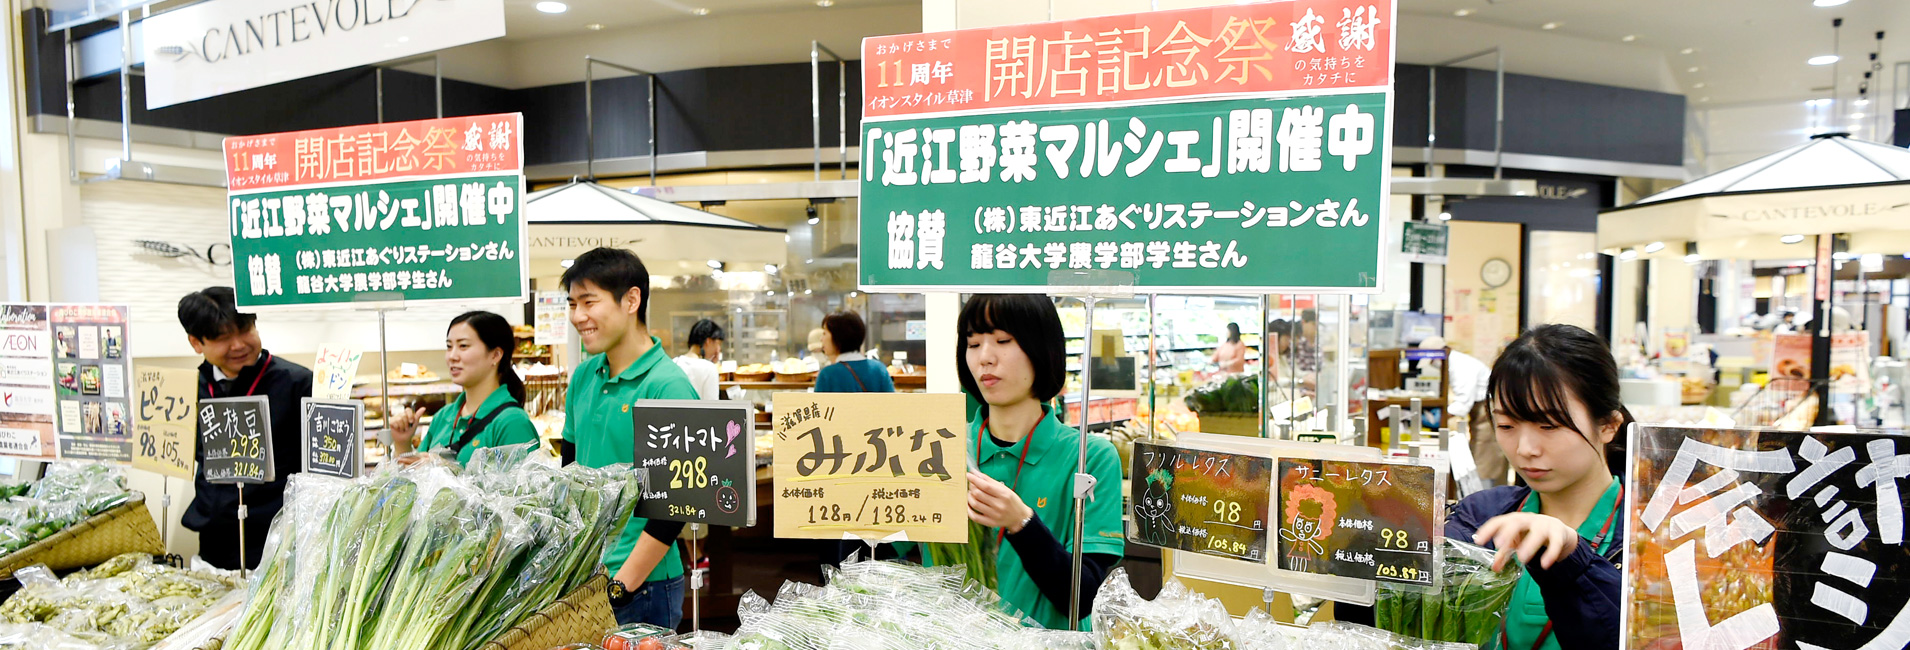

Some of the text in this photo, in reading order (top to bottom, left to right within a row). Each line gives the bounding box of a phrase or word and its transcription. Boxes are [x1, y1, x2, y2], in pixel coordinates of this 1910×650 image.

[1284, 4, 1381, 54] 感謝
[876, 38, 951, 56] おかげさまで
[984, 15, 1278, 102] 開店記念祭
[877, 59, 954, 88] 11周年
[1295, 55, 1365, 71] の気持ちを
[1303, 72, 1356, 86] カタチに
[868, 88, 973, 110] イオンスタイル草津
[231, 138, 276, 149] おかげさまで
[294, 126, 459, 181] 開店記念祭
[466, 153, 505, 162] の気持ちを
[866, 103, 1375, 187] 「近江野菜マルシェ」開催中
[233, 152, 278, 171] 11周年
[231, 172, 289, 187] イオンスタイル草津
[232, 181, 514, 239] 「近江野菜マルシェ」開催中
[1742, 203, 1878, 222] CANTEVOLE
[529, 237, 619, 248] ANTEVOLE
[887, 209, 946, 271] 協賛
[970, 240, 1248, 270] 龍谷大学農学部学生さん
[248, 252, 283, 296] 協賛
[296, 269, 452, 294] 龍谷大学農学部学生さん
[140, 386, 190, 421] ピーマン
[780, 402, 821, 430] 滋賀県産
[200, 404, 261, 443] 黒枝豆
[647, 423, 722, 453] ミディトマト
[796, 425, 956, 481] みぶな
[1295, 465, 1392, 486] サニーレタス
[782, 487, 921, 499] 本体価格 税込価格
[1640, 435, 1910, 558] 会計
